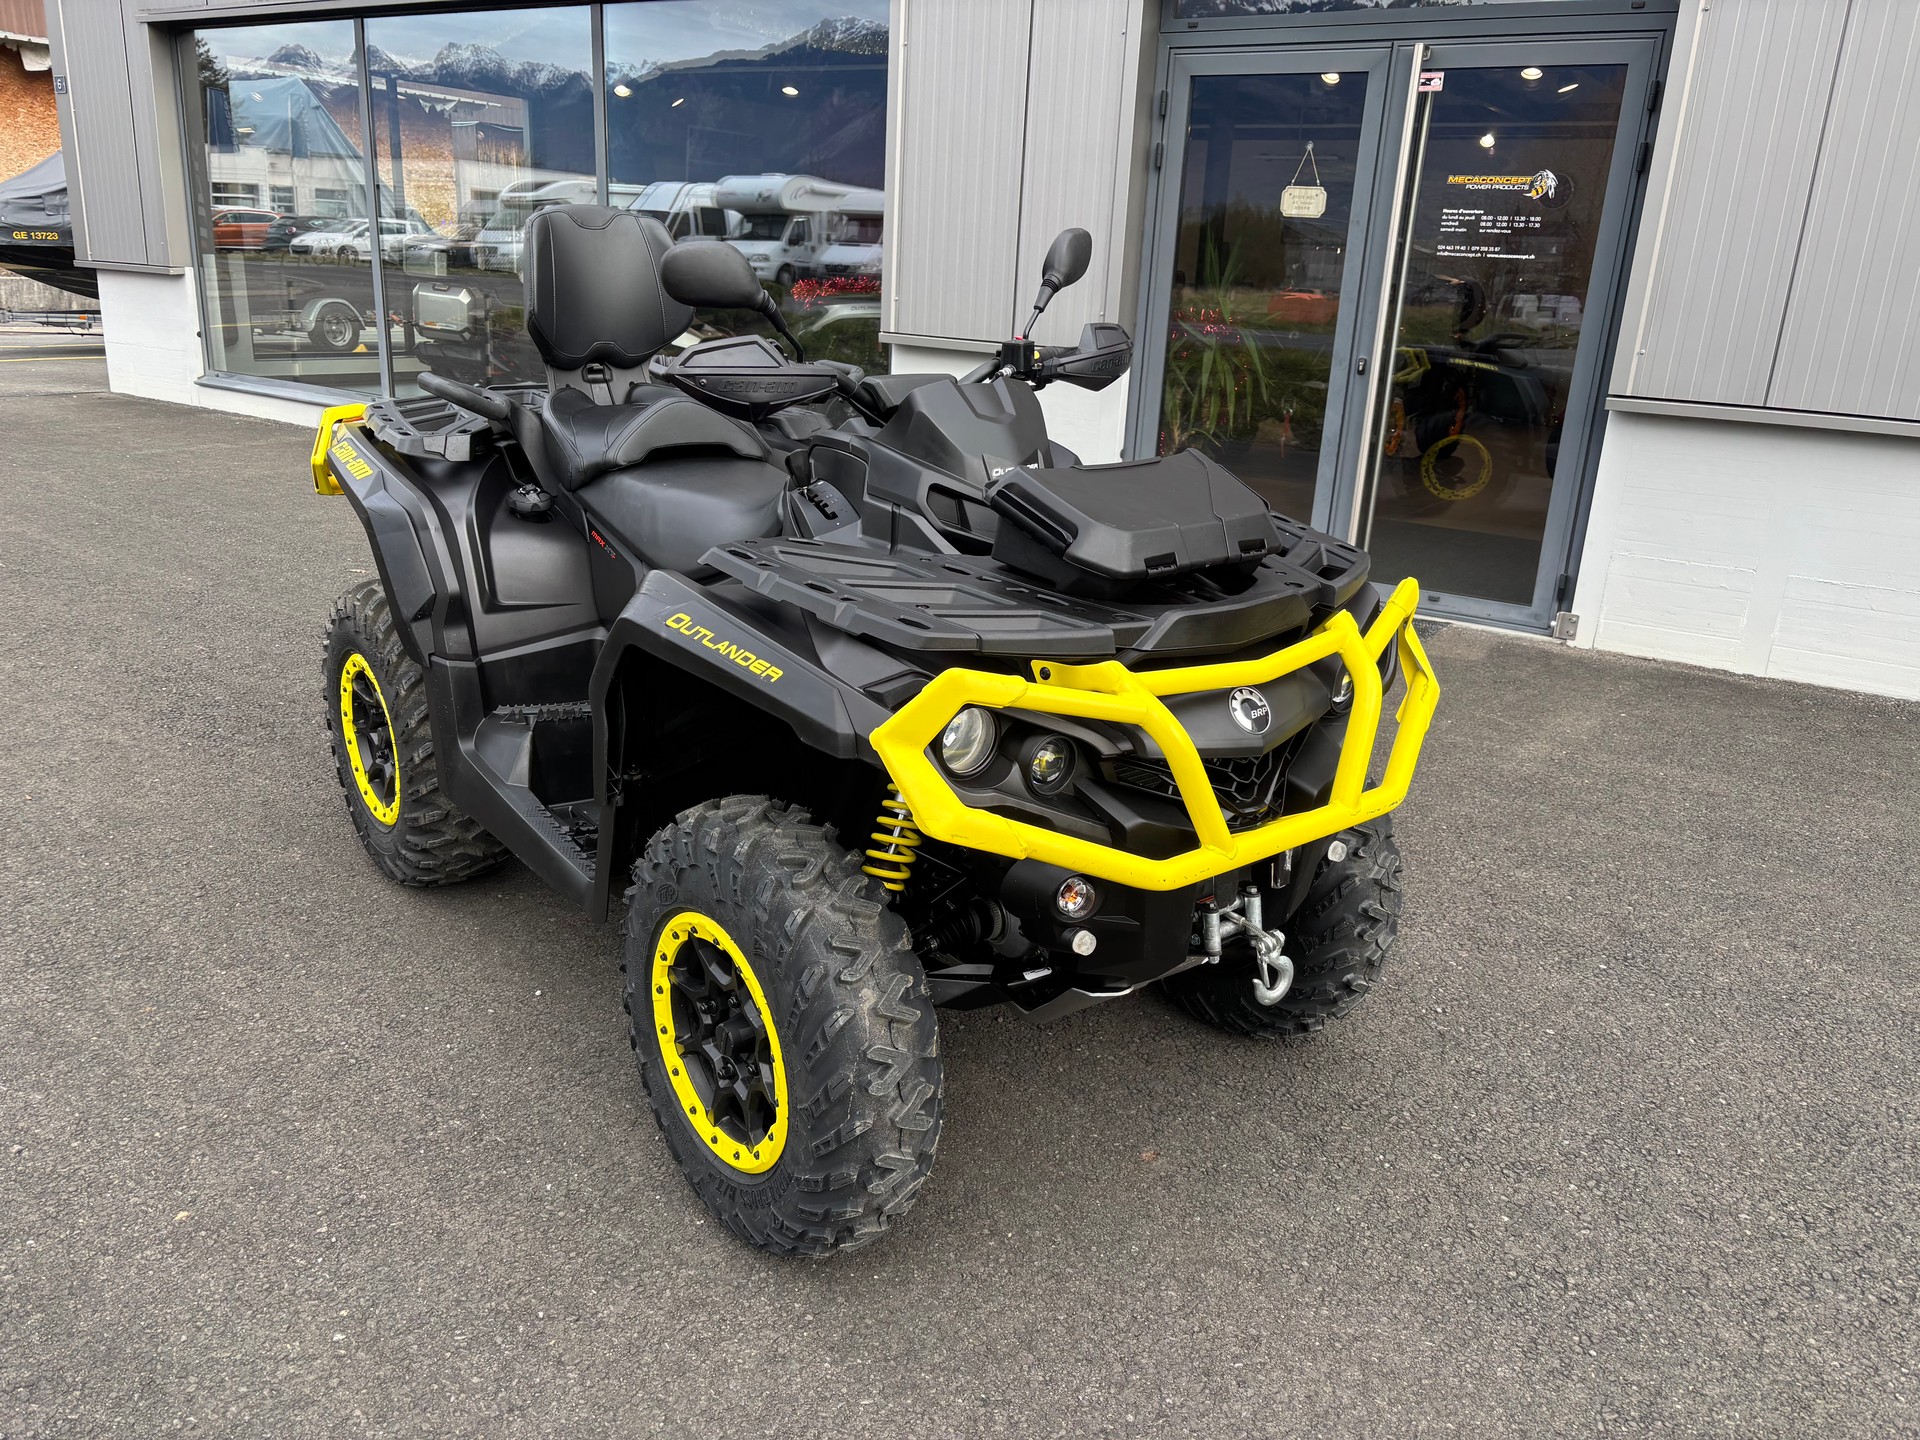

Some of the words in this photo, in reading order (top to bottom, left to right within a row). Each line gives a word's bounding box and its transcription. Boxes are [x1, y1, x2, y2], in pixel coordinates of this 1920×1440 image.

[1447, 175, 1533, 184] MECACONCEPT
[12, 230, 28, 240] GE
[30, 231, 59, 241] 13723
[665, 612, 784, 682] OUTLANDER
[1250, 706, 1268, 719] BRP
